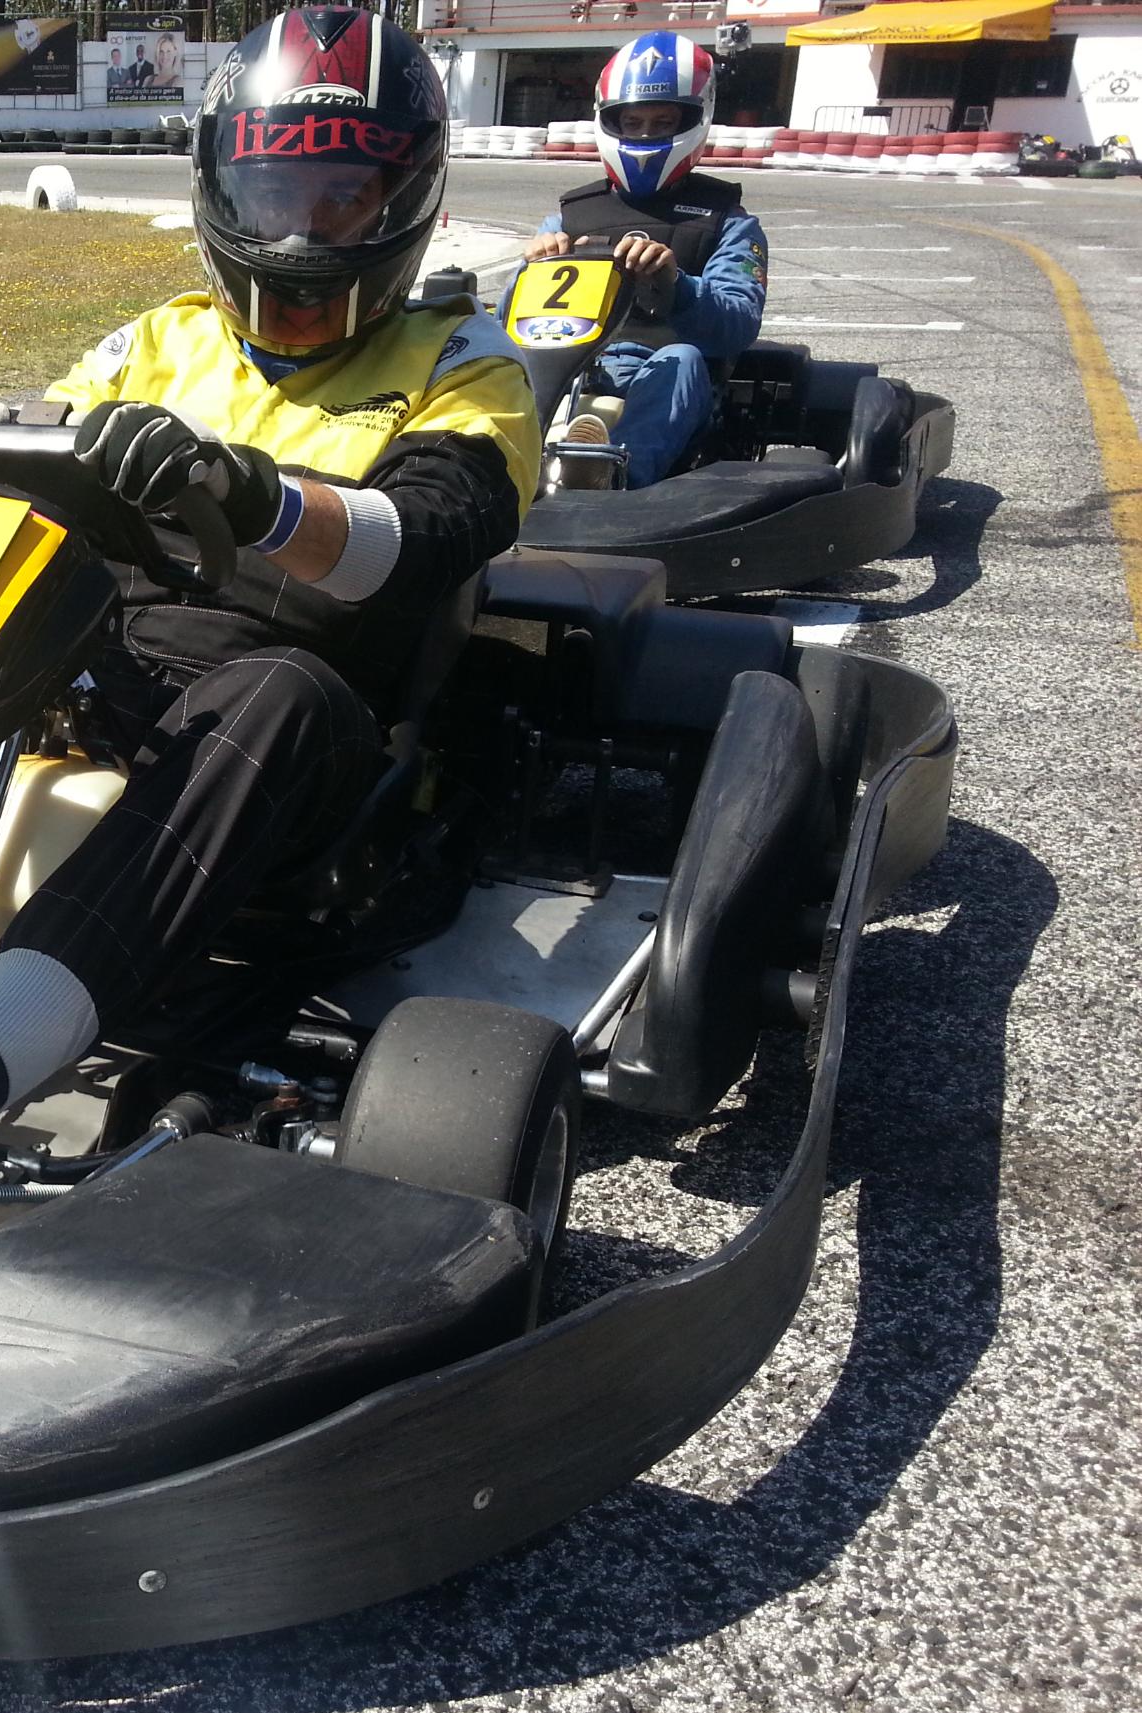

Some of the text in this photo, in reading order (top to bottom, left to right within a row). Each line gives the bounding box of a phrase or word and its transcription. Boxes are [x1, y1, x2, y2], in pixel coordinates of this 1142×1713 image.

[626, 83, 671, 95] SHARK
[231, 107, 416, 165] liztrez
[542, 265, 580, 309] 2
